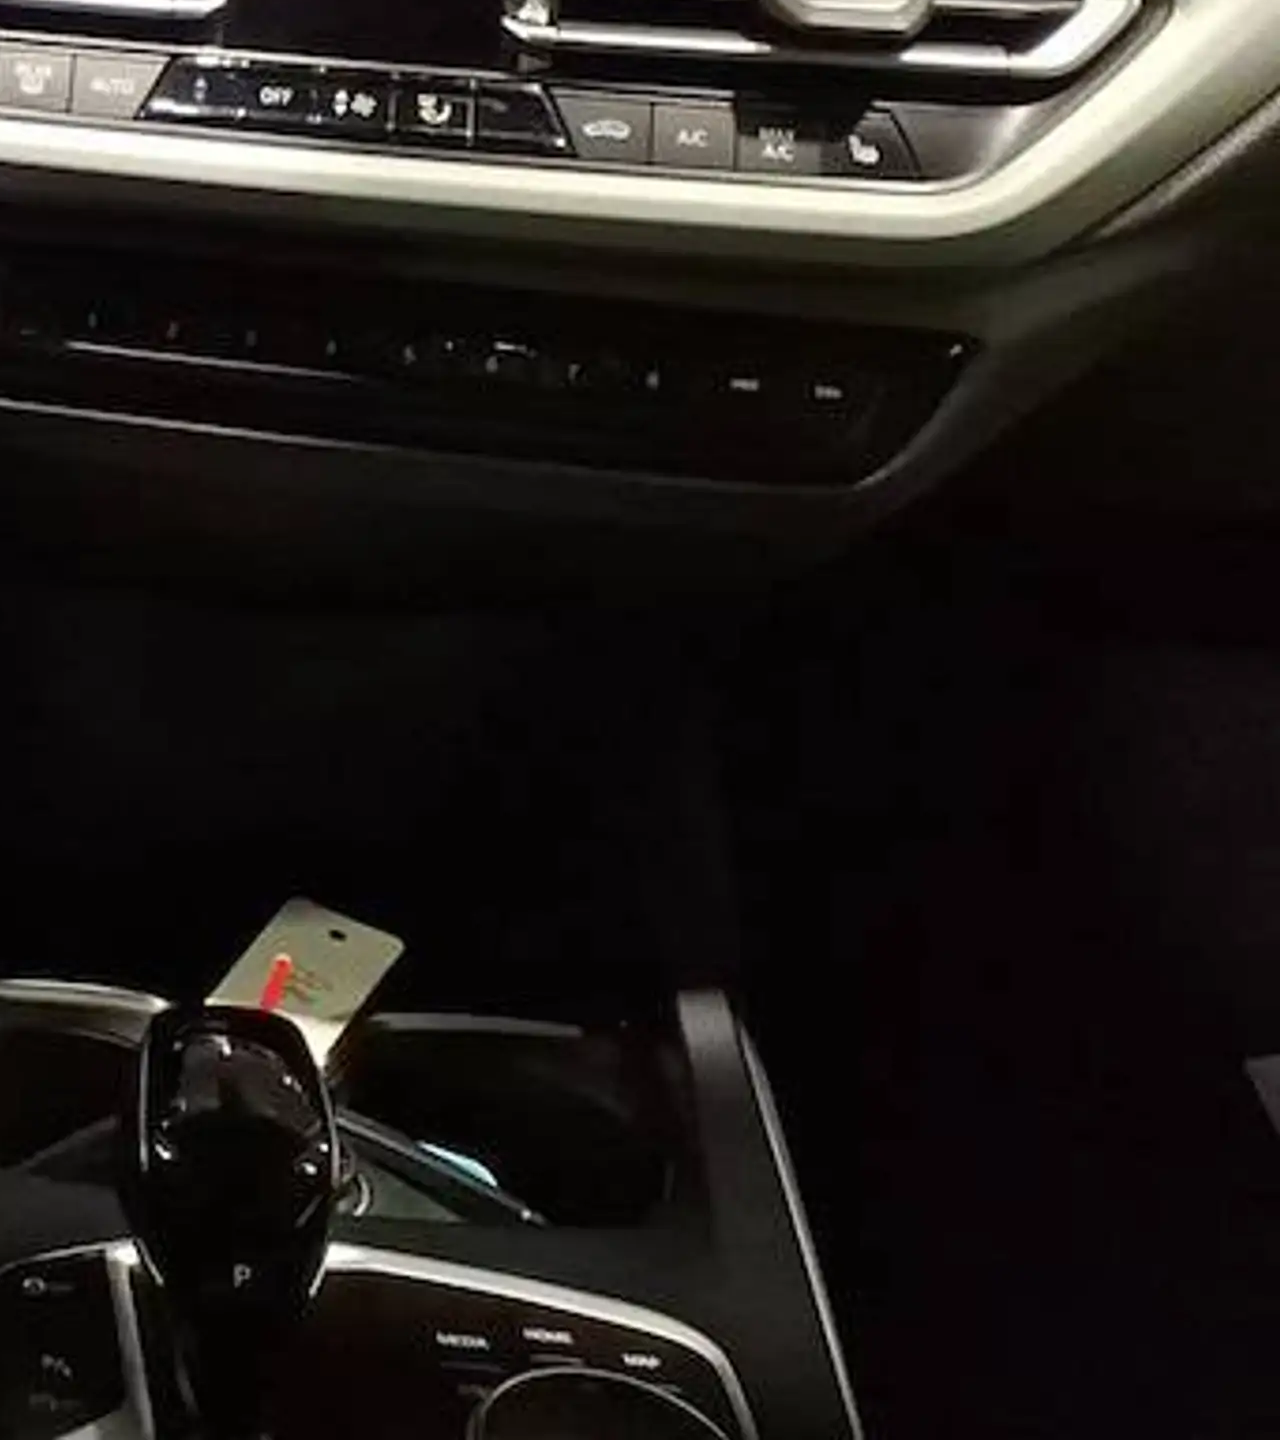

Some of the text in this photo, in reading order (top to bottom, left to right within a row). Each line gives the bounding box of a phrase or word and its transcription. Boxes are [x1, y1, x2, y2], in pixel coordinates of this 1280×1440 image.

[258, 85, 293, 107] OFF
[675, 128, 709, 148] A/C
[760, 143, 796, 162] A/C
[233, 1263, 251, 1288] P
